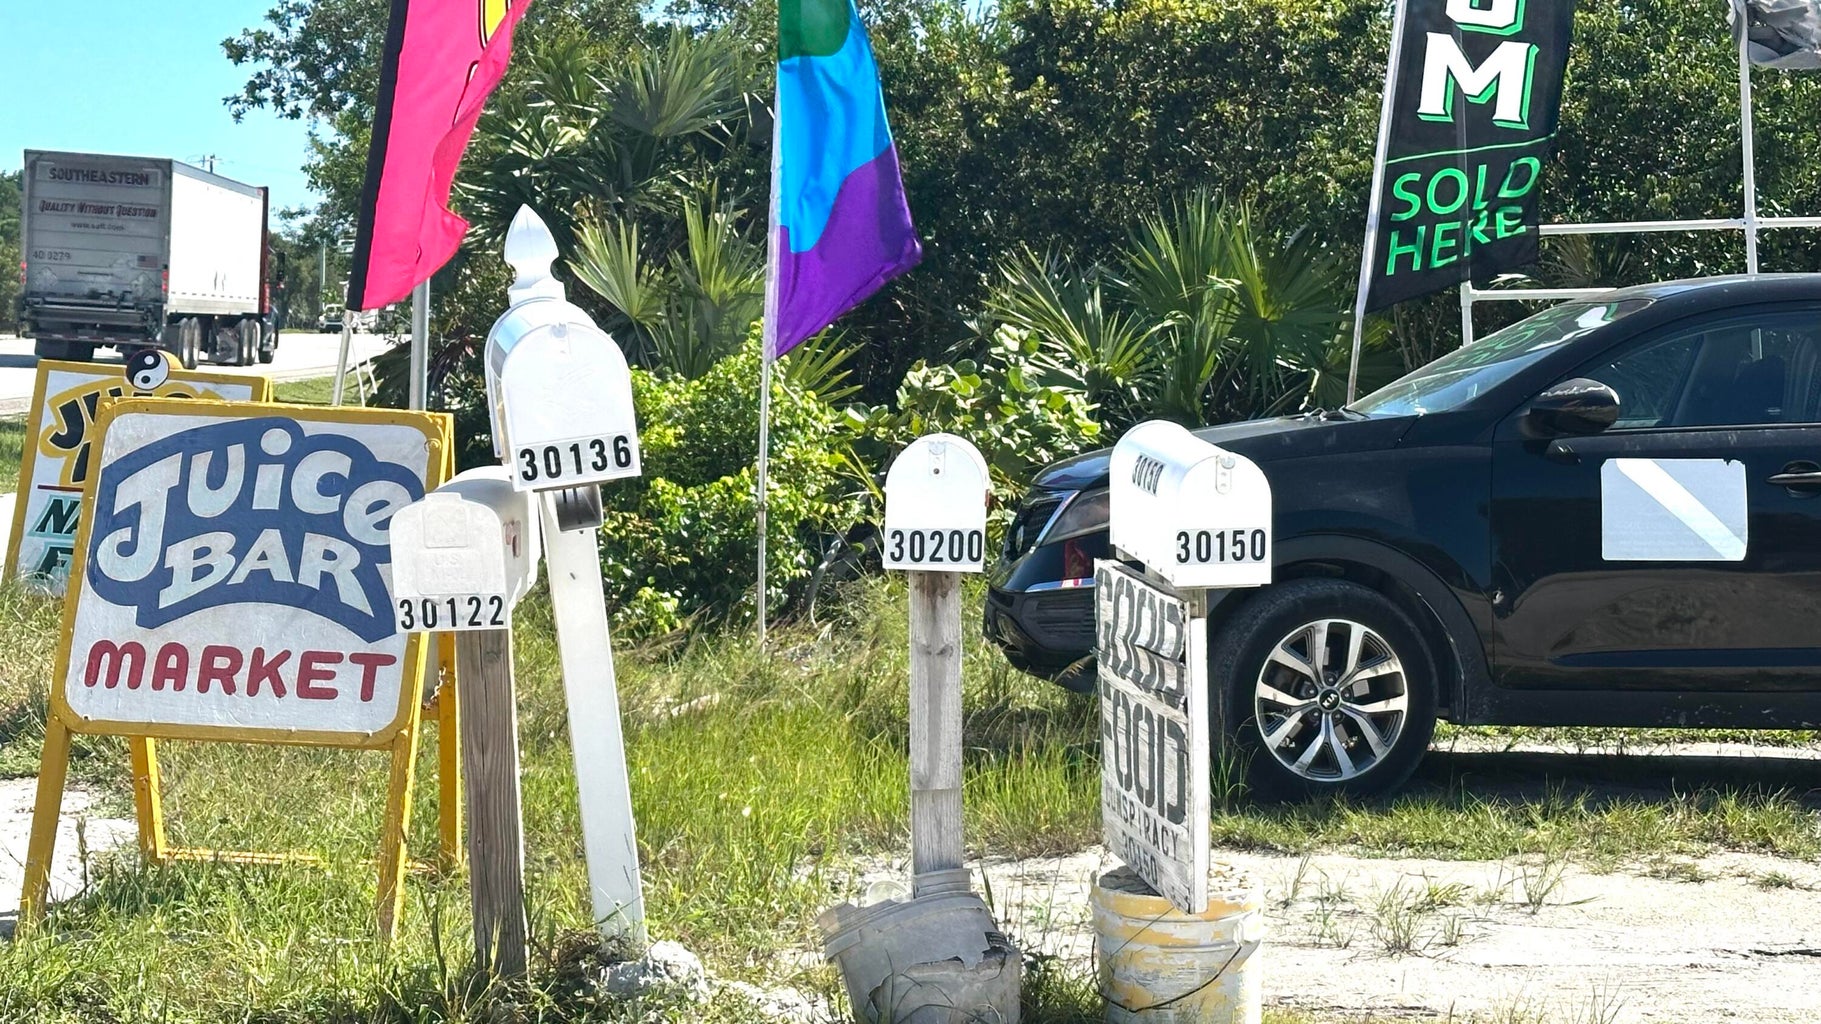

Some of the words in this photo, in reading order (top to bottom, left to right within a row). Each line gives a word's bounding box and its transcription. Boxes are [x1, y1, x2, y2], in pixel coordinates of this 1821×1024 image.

[49, 167, 149, 185] SOUTHEASTERN
[1391, 157, 1541, 222] SOLD
[78, 202, 115, 215] WITHOUT
[116, 205, 157, 217] QUESTION
[1386, 206, 1527, 276] HERE
[519, 434, 632, 482] 30136
[1132, 454, 1164, 495] 30150
[890, 529, 983, 563] 30200
[1176, 528, 1266, 563] 30150
[159, 528, 374, 618] BAR
[399, 595, 505, 630] 30122
[84, 638, 397, 702] MARKET
[1099, 677, 1187, 826] FOOD
